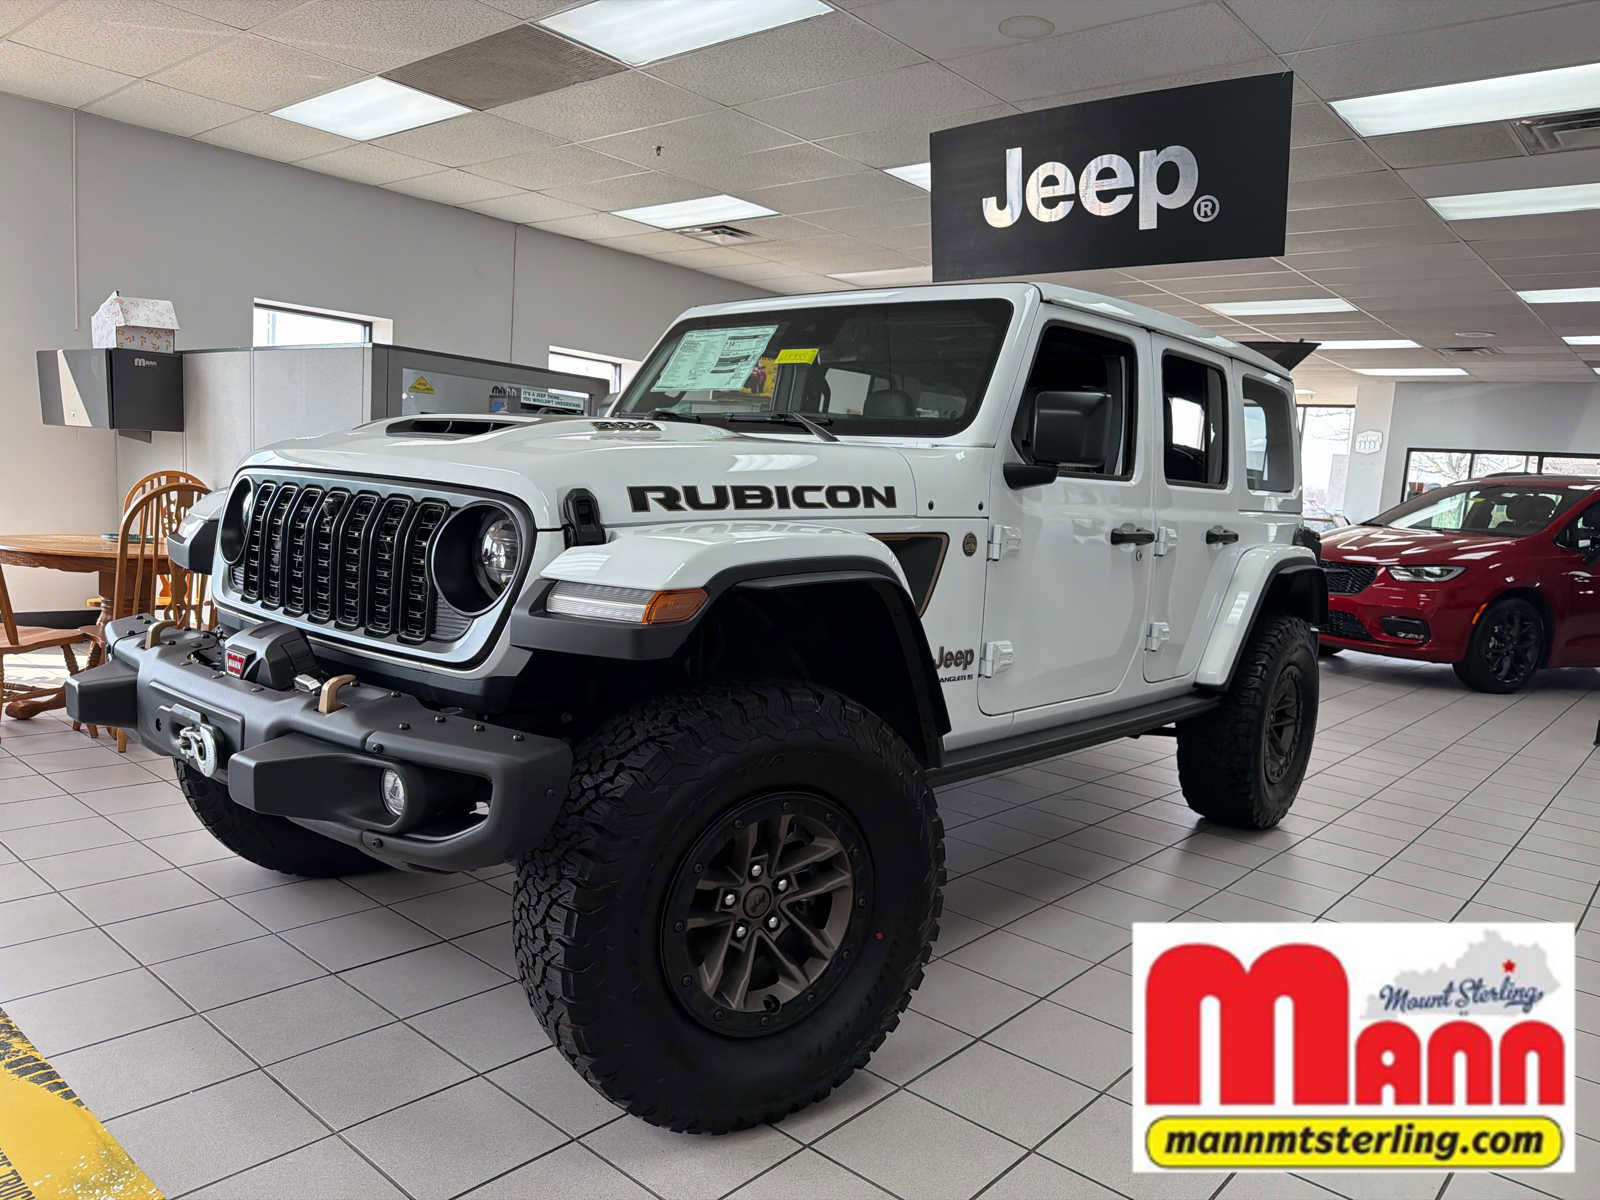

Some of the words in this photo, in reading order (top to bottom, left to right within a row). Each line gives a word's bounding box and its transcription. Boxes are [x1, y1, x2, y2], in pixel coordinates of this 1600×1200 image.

[982, 145, 1199, 230] Jeep
[627, 485, 897, 512] RUBICON
[935, 646, 975, 671] Jeep
